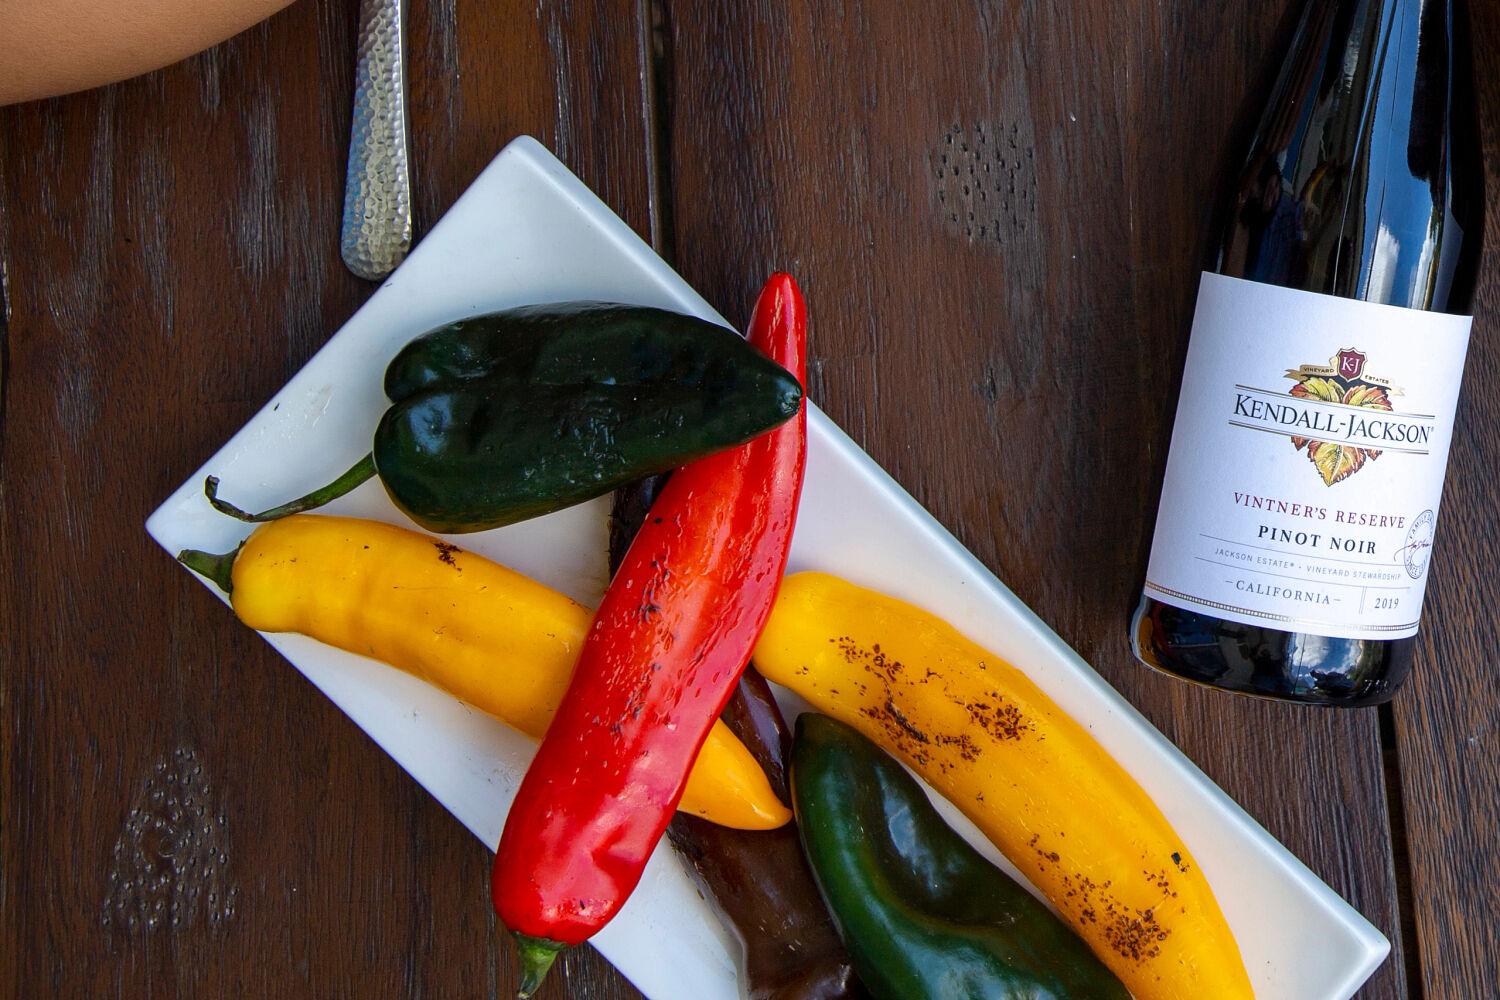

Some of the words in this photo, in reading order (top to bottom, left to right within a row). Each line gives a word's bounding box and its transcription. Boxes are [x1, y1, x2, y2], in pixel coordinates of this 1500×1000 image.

[1234, 492, 1327, 520] VINTNER'S
[1335, 510, 1405, 529] RESERVE
[1258, 525, 1321, 548] PINOT
[1329, 537, 1377, 555] NOIR
[1214, 547, 1253, 562] JACKSON
[1307, 565, 1350, 578] VINEYARD
[1353, 571, 1401, 581] STEWARDSHIP
[1374, 598, 1400, 610] 2019
